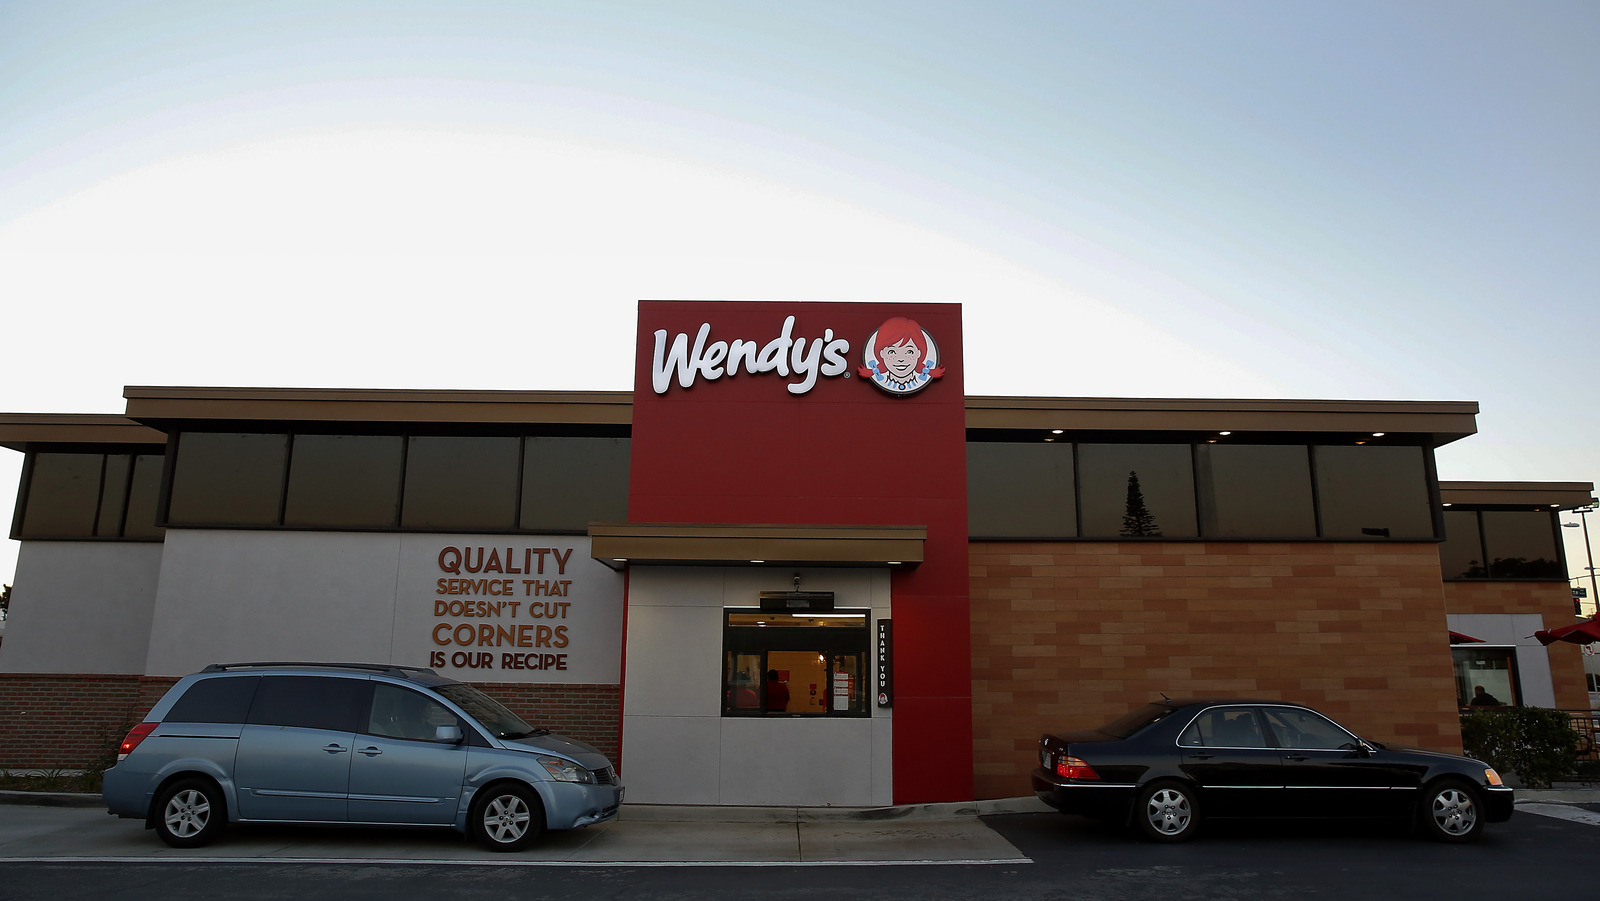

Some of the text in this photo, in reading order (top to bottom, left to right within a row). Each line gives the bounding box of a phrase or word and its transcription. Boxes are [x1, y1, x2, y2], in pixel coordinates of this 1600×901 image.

[652, 315, 850, 394] Wendy's
[438, 546, 574, 575] QUALITY
[436, 578, 572, 597] SERVICE THAT
[434, 600, 571, 619] DOESN'T CUT
[432, 623, 569, 648] CORNERS
[430, 651, 567, 670] IS OUR RECIPE
